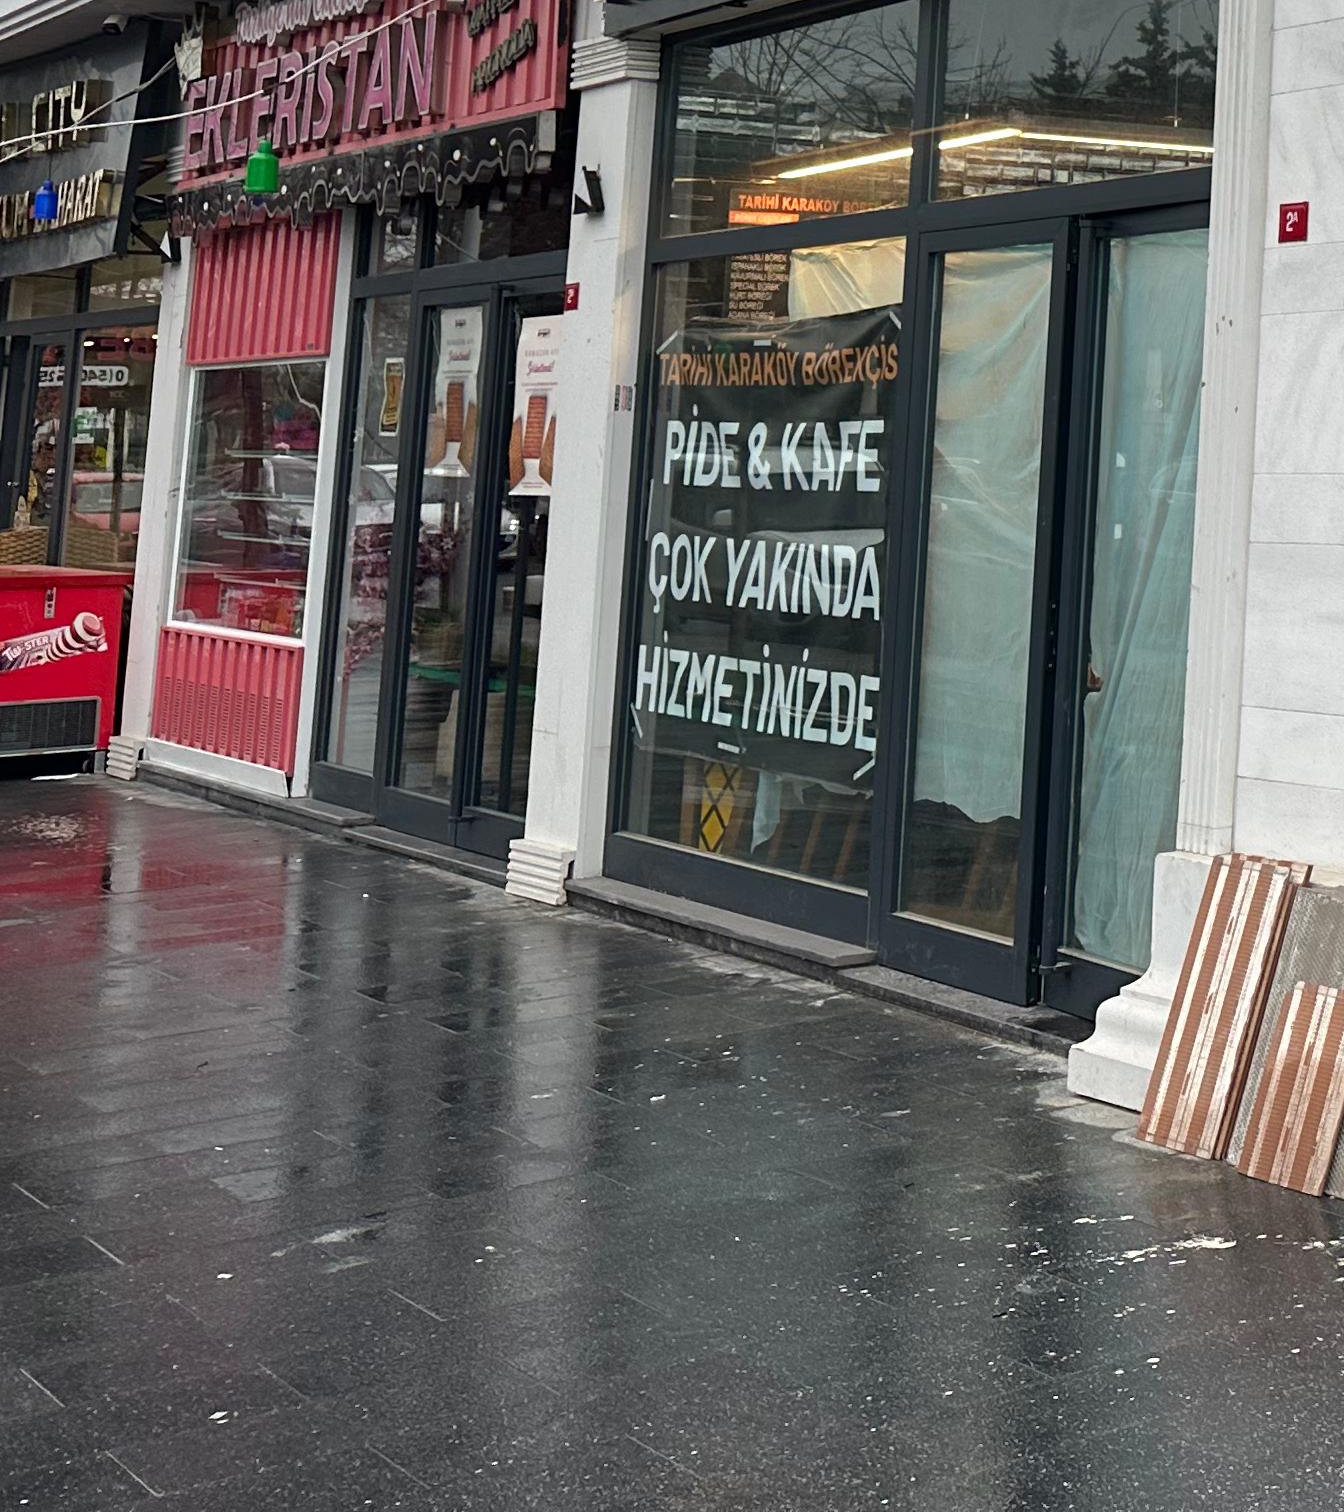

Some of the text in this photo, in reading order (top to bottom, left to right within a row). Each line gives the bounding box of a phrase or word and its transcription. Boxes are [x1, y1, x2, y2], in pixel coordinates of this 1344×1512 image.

[31, 80, 88, 153] CITY
[33, 169, 104, 233] HARAT
[738, 193, 779, 210] TARİHİ
[659, 344, 713, 386] TARİHİ
[715, 342, 799, 386] KARAKÖY
[663, 403, 885, 492] PİDE & KAFE
[649, 531, 880, 621] ÇOK YAKINDA
[635, 630, 880, 752] HİZMETİNİZDE
